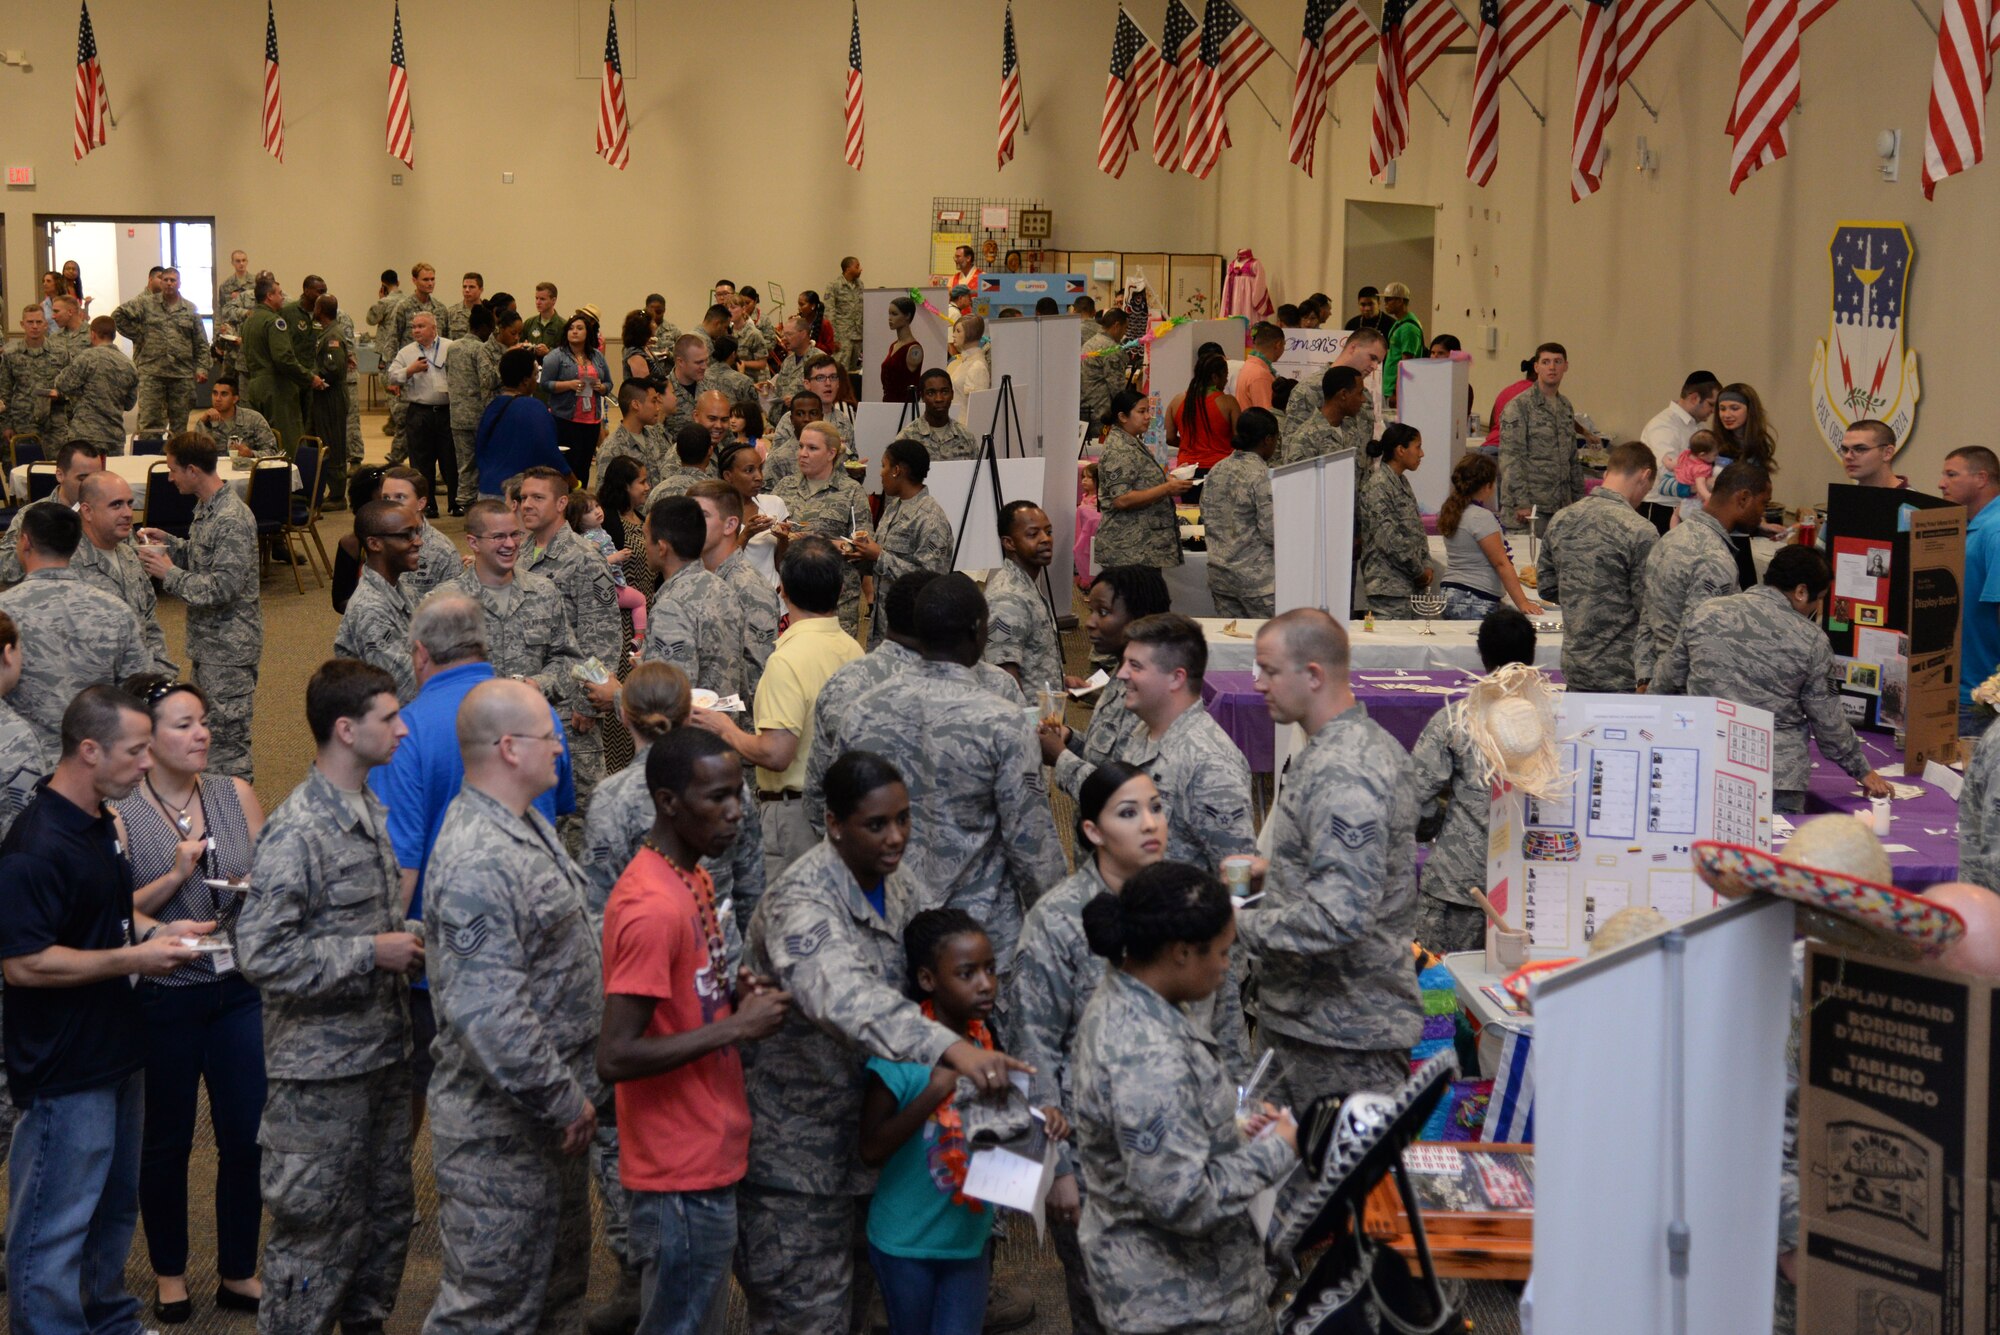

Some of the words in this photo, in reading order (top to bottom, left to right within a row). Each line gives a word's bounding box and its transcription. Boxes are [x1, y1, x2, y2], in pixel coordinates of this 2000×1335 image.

[9, 167, 31, 184] EXIT
[1817, 395, 1830, 430] PAX
[1820, 981, 1888, 1008] DISPLAY
[1891, 996, 1954, 1024] BOARD
[1834, 1024, 1943, 1062] D'AFFICHAGE
[1848, 1011, 1930, 1042] BORDURE
[1831, 1067, 1852, 1086] DE
[1857, 1074, 1939, 1107] PLEGADO
[1847, 1053, 1925, 1086] TABLERO
